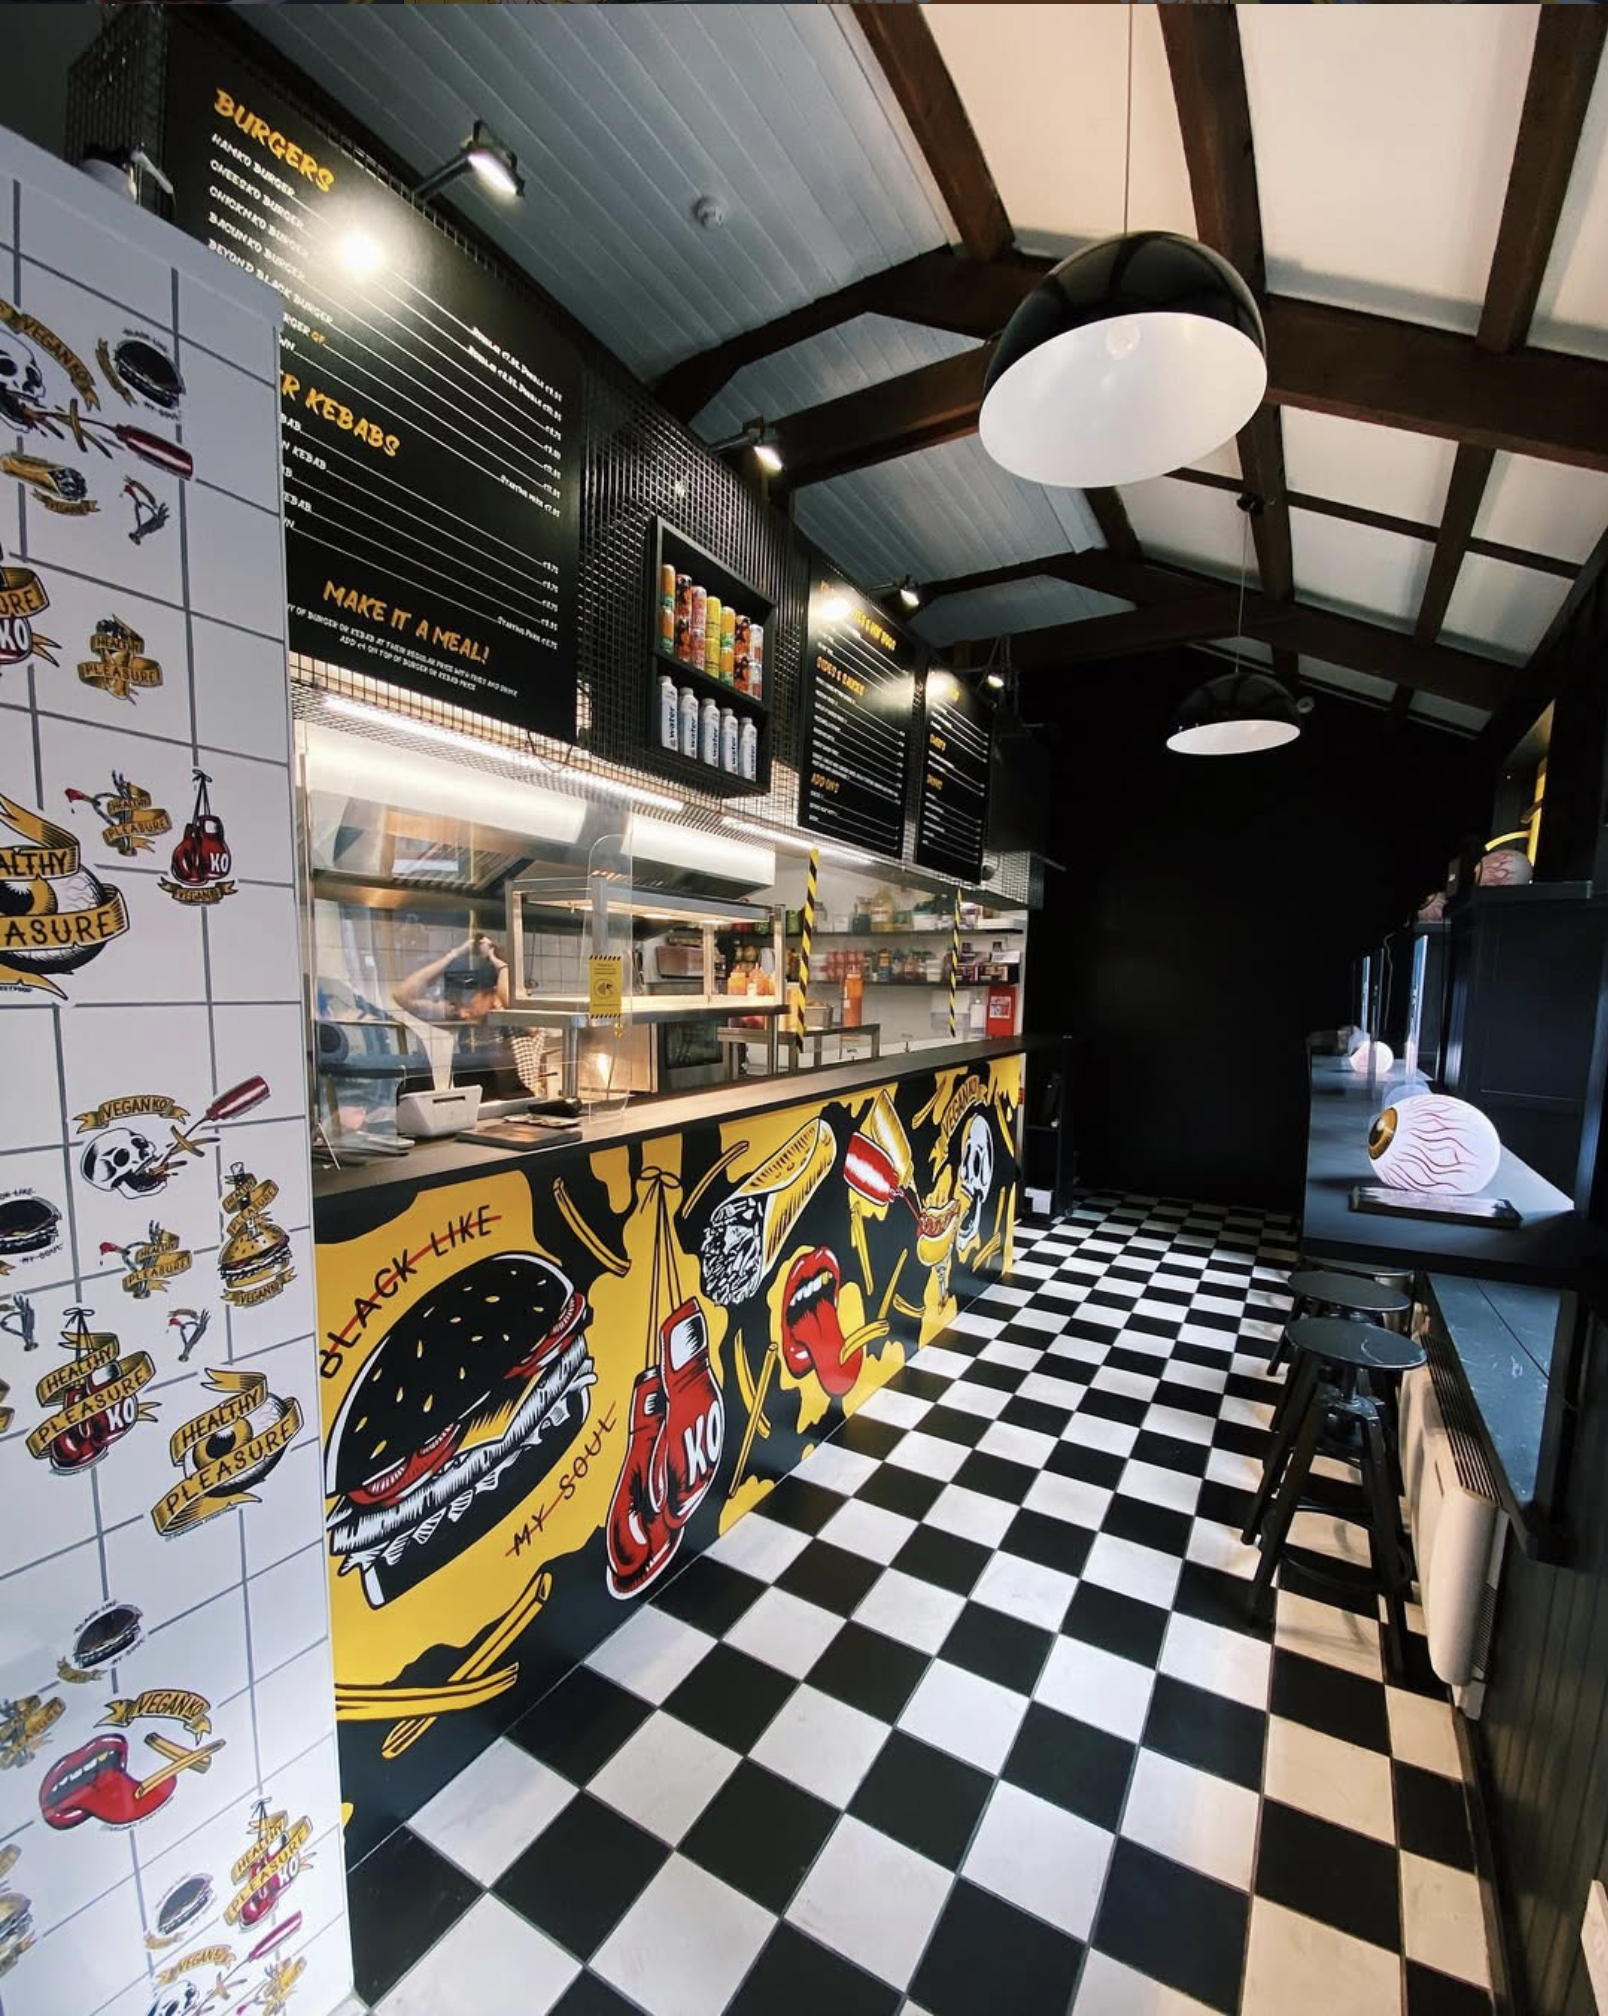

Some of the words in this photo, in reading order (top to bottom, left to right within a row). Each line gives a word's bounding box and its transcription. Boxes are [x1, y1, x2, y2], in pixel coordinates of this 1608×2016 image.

[214, 88, 334, 192] BURGERS
[208, 238, 255, 273] BEYOND
[305, 387, 400, 457] KEBABS
[292, 445, 327, 470] KEBAB
[322, 580, 388, 622] MAKE
[390, 607, 412, 631] IT
[415, 619, 429, 641] A
[432, 626, 490, 665] MEAL!
[340, 635, 357, 647] ADD
[85, 663, 156, 684] PLEASURE
[108, 817, 167, 837] PLEASURE
[209, 852, 230, 873] KO
[319, 1249, 418, 1379] BLACK
[430, 1204, 493, 1258] LIKE
[46, 1346, 112, 1392] HEALTHY
[39, 1367, 147, 1442] PLEASURE
[107, 1402, 134, 1431] KO
[181, 1388, 260, 1448] HEALTHY
[166, 1419, 293, 1515] PLEASURE
[685, 1408, 721, 1482] KO
[511, 1504, 547, 1557] MY
[559, 1416, 617, 1500] SOUL
[232, 1827, 306, 1911] PLEASURE
